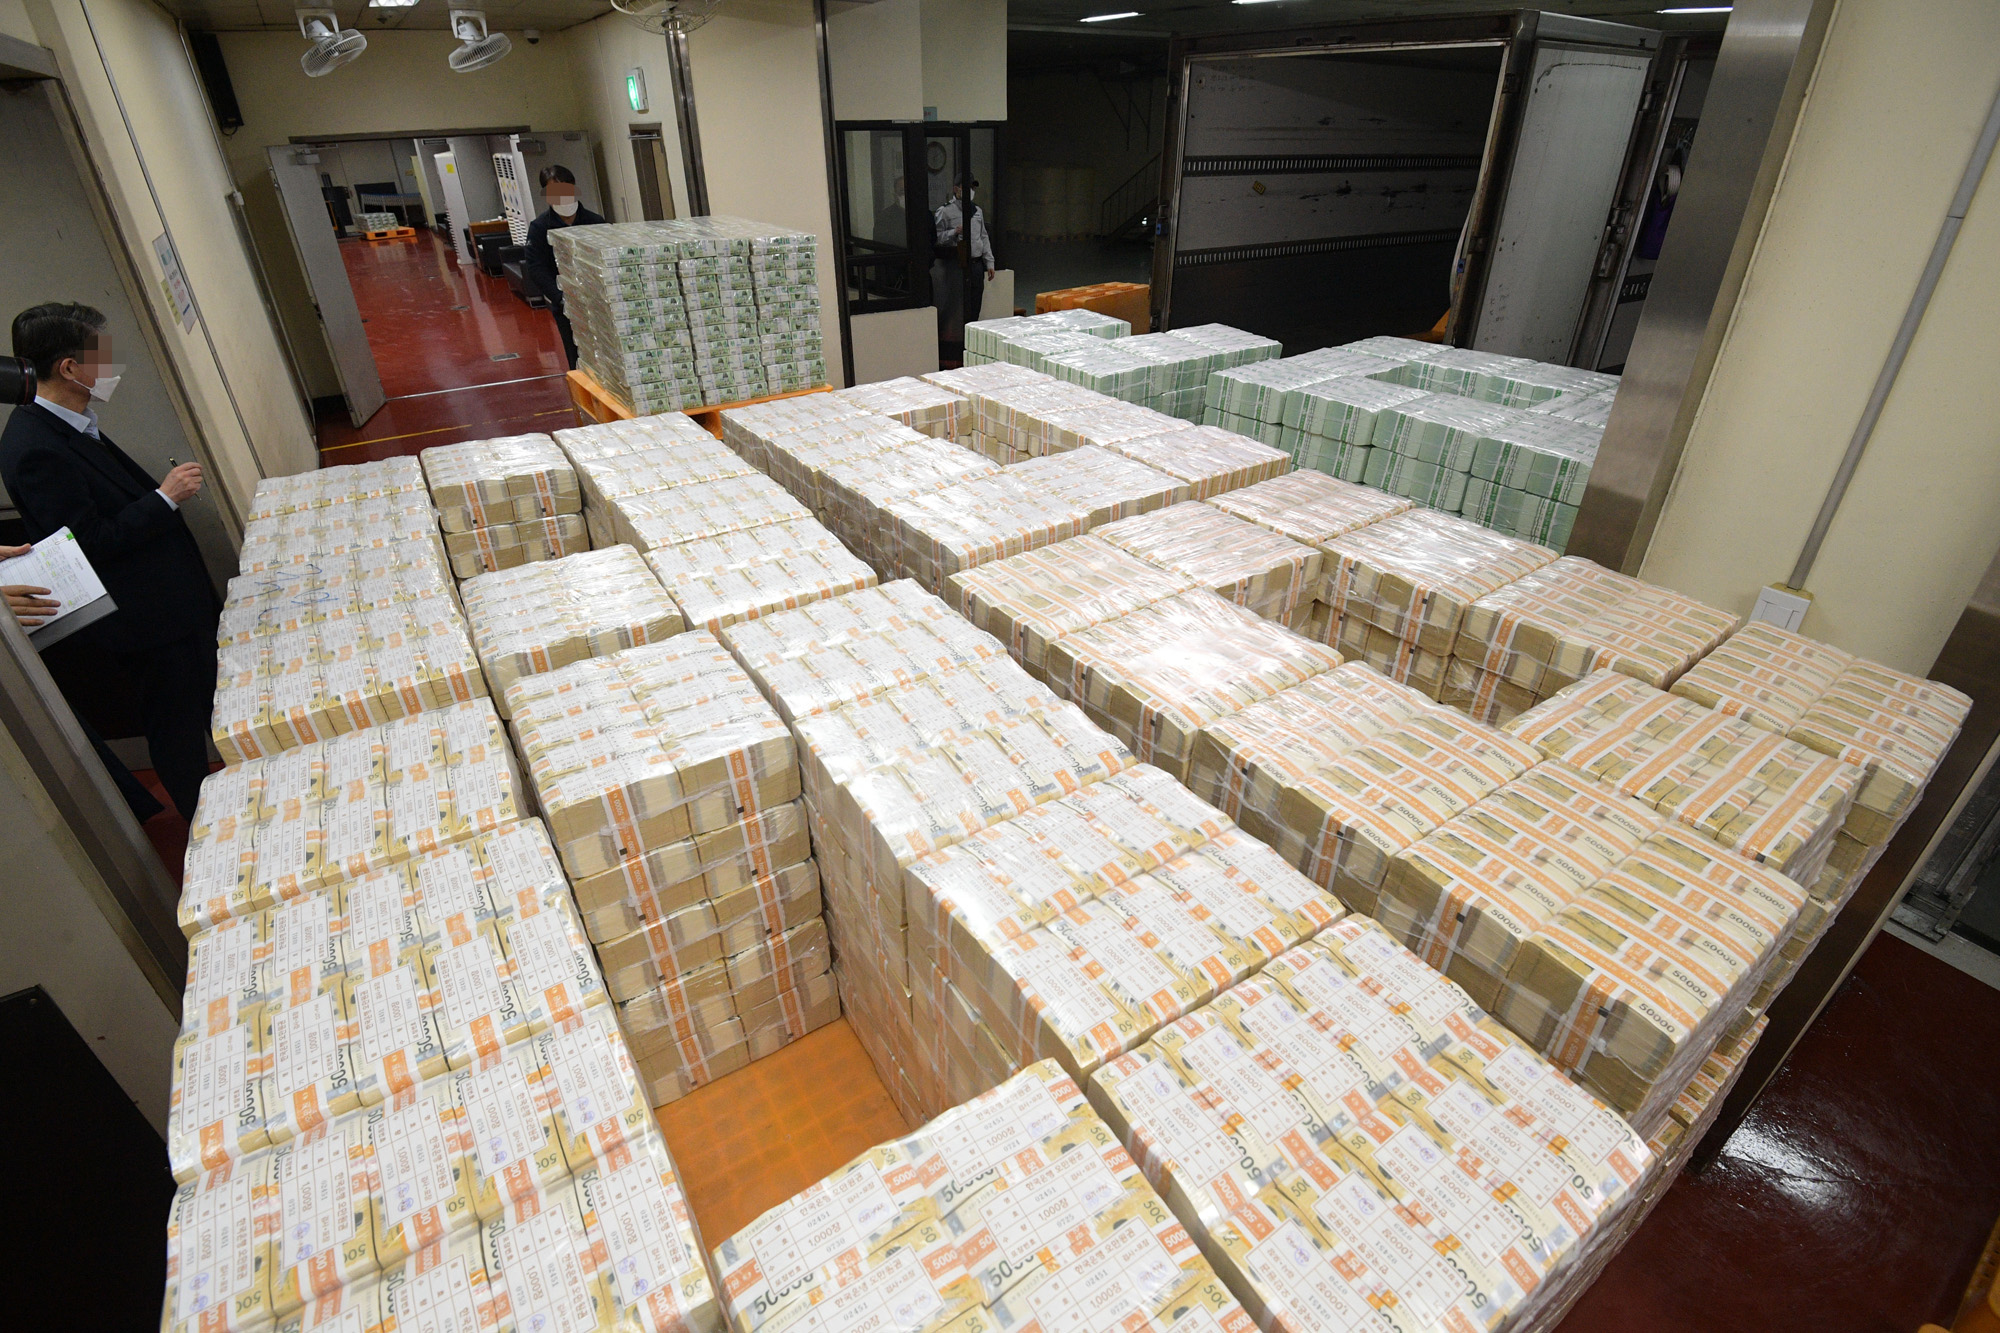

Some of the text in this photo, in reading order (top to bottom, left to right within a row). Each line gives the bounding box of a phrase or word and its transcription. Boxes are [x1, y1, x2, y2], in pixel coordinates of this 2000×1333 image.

[1758, 712, 1784, 729] 50000
[1491, 749, 1515, 767] 50000
[1263, 763, 1286, 782] 50000
[1461, 768, 1486, 786] 50000
[1431, 786, 1457, 806] 50000
[1399, 806, 1424, 826] 50000
[1612, 814, 1641, 835] 50000
[1362, 828, 1391, 850] 50000
[1584, 836, 1615, 858] 50000
[1555, 858, 1586, 881] 50000
[1524, 883, 1555, 908] 50000
[1752, 886, 1786, 911] 50000
[1490, 909, 1522, 934] 50000
[1729, 913, 1762, 938] 50000
[1702, 940, 1737, 967] 50000
[1672, 970, 1707, 999] 50000
[1638, 1003, 1675, 1033] 50000
[571, 1063, 586, 1089] 1,000장
[485, 1101, 500, 1129] 1,000장
[1489, 1124, 1522, 1152] 1,000장
[396, 1145, 409, 1175] 1,000장
[1439, 1173, 1472, 1204] 1,000장
[1037, 1196, 1069, 1221] 1,000장
[1561, 1200, 1589, 1233] 50000
[619, 1211, 637, 1245] 1,000장
[807, 1221, 842, 1249] 1,000장
[1381, 1226, 1415, 1260] 1,000장
[525, 1264, 543, 1301] 1,000장
[1089, 1281, 1123, 1309] 1,000장
[1313, 1280, 1350, 1315] 1,000장
